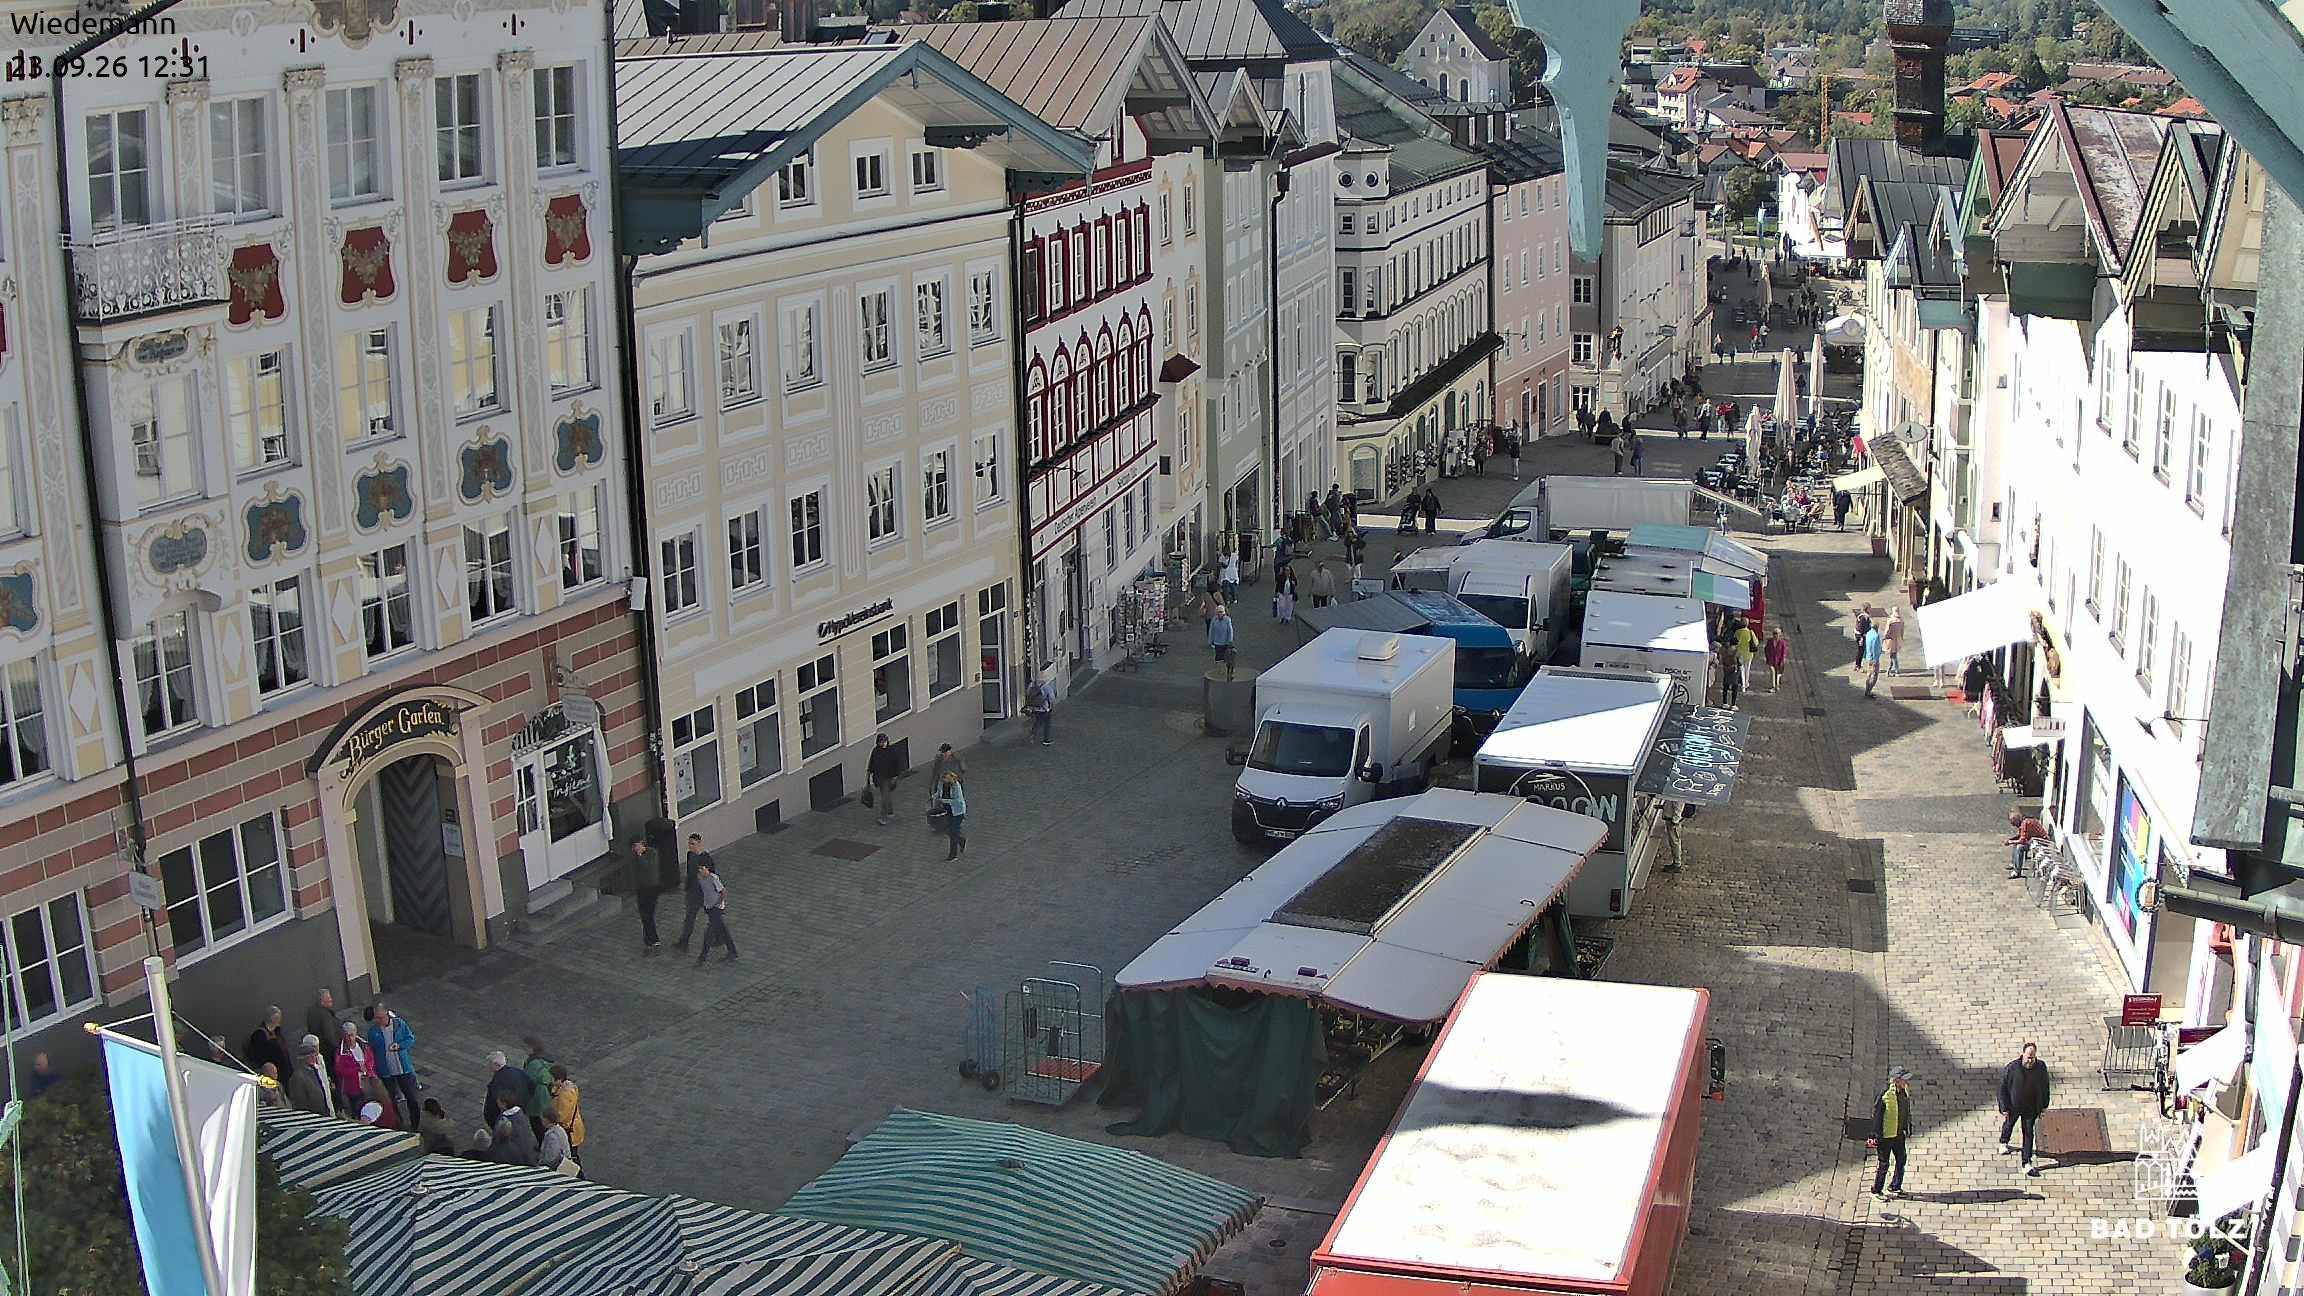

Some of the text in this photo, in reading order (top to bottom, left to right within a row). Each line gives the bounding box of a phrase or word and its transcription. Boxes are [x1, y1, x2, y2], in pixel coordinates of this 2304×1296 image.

[349, 702, 443, 767] Bürger Garten
[1533, 782, 1566, 793] MARKUS
